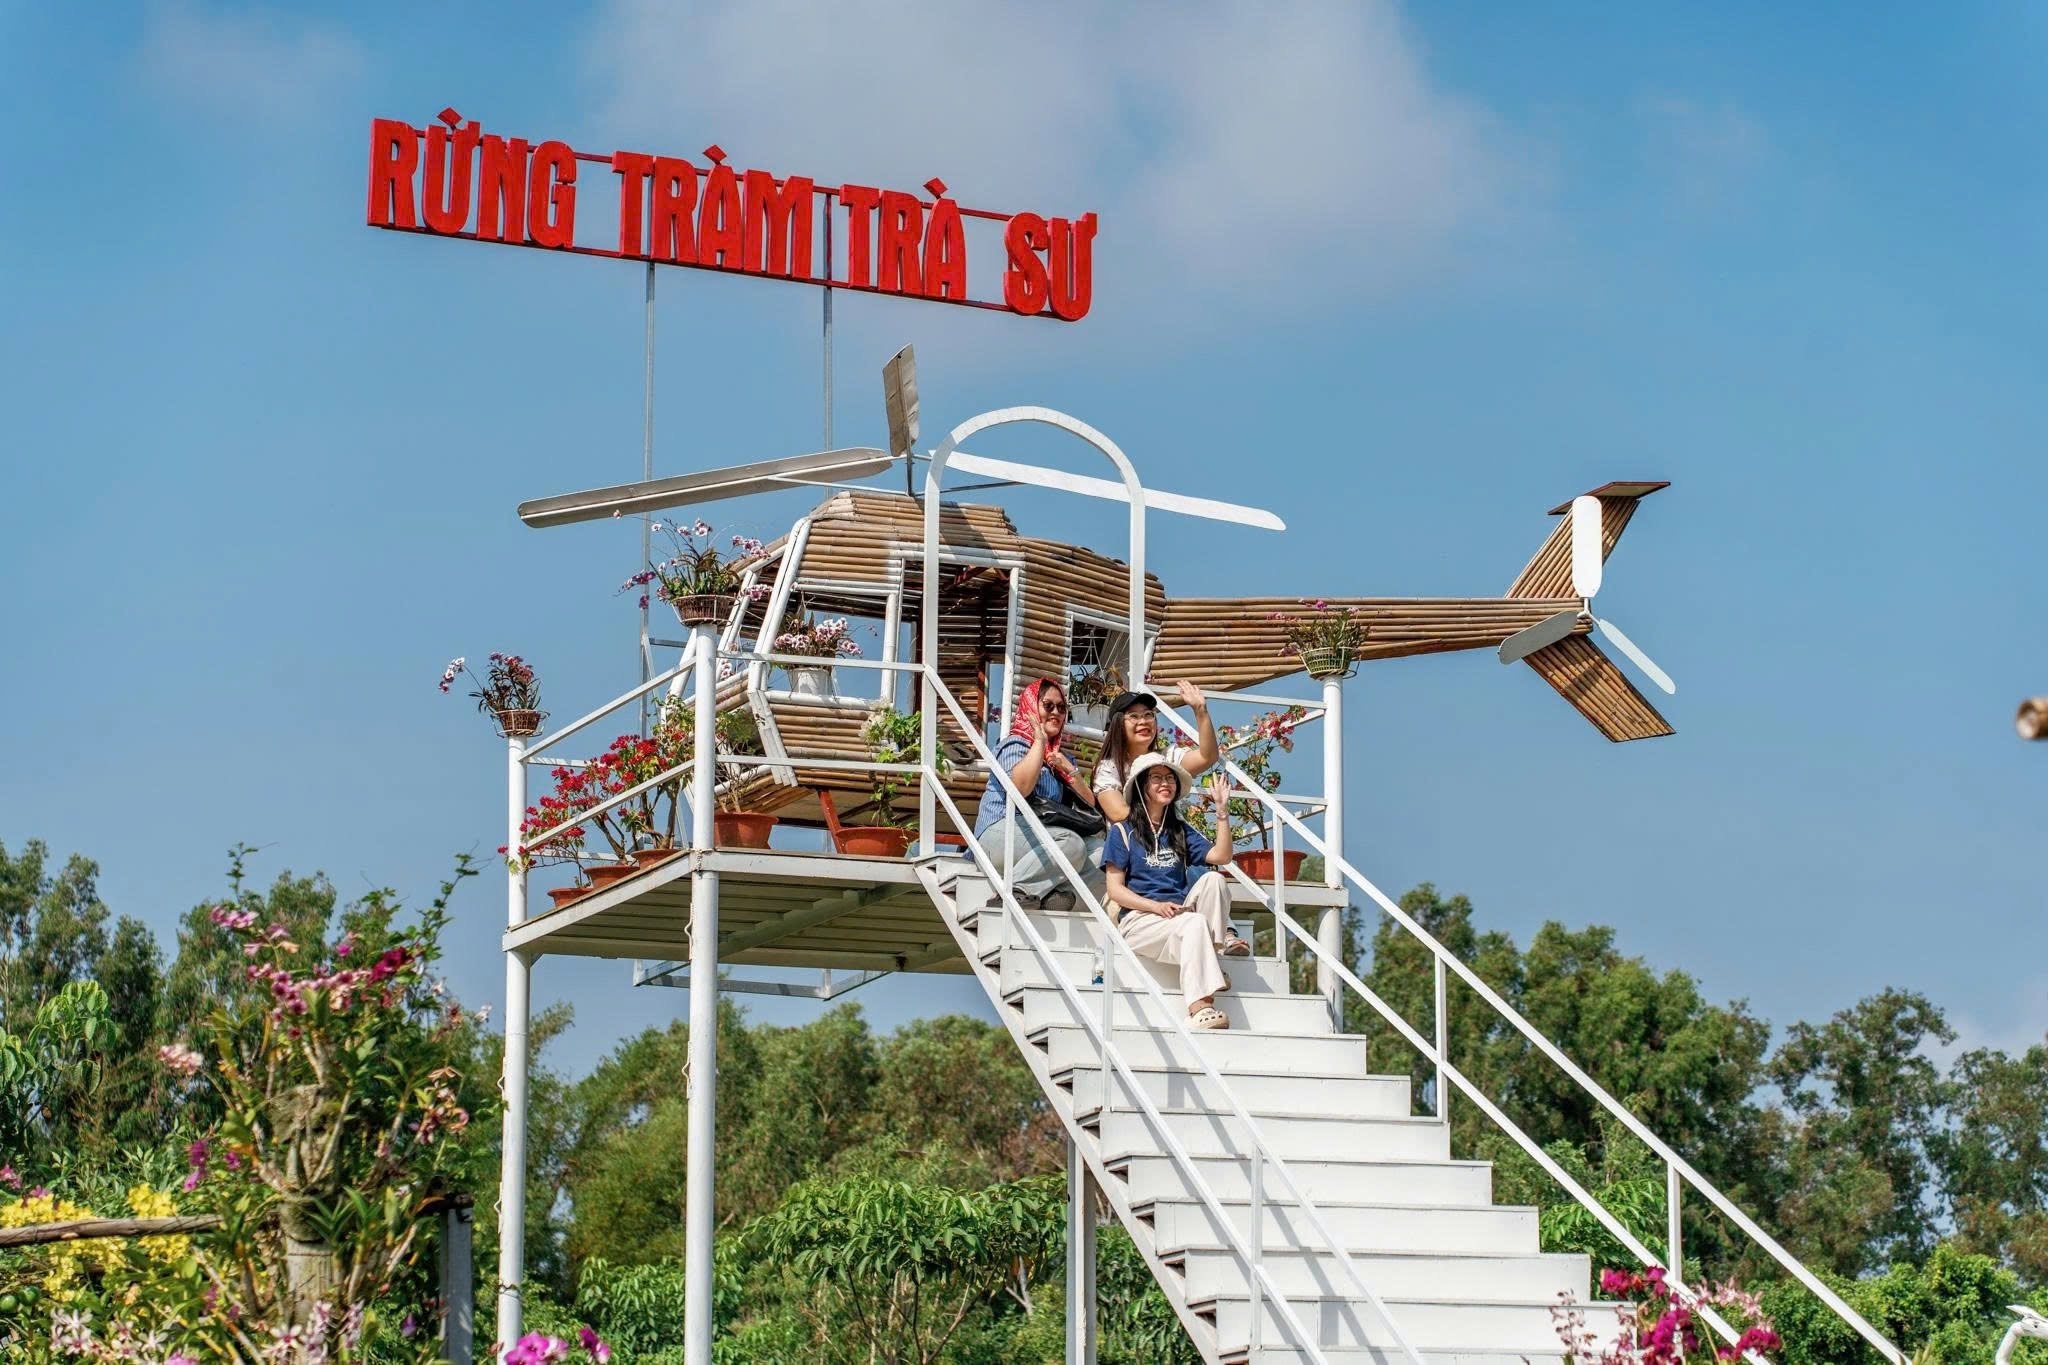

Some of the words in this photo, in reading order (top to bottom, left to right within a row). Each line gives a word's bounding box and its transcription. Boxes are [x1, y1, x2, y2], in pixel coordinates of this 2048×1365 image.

[367, 107, 577, 248] RỪNG
[612, 144, 813, 279] TRÀM
[839, 177, 967, 300] TRÀ
[1003, 212, 1098, 322] SƯ
